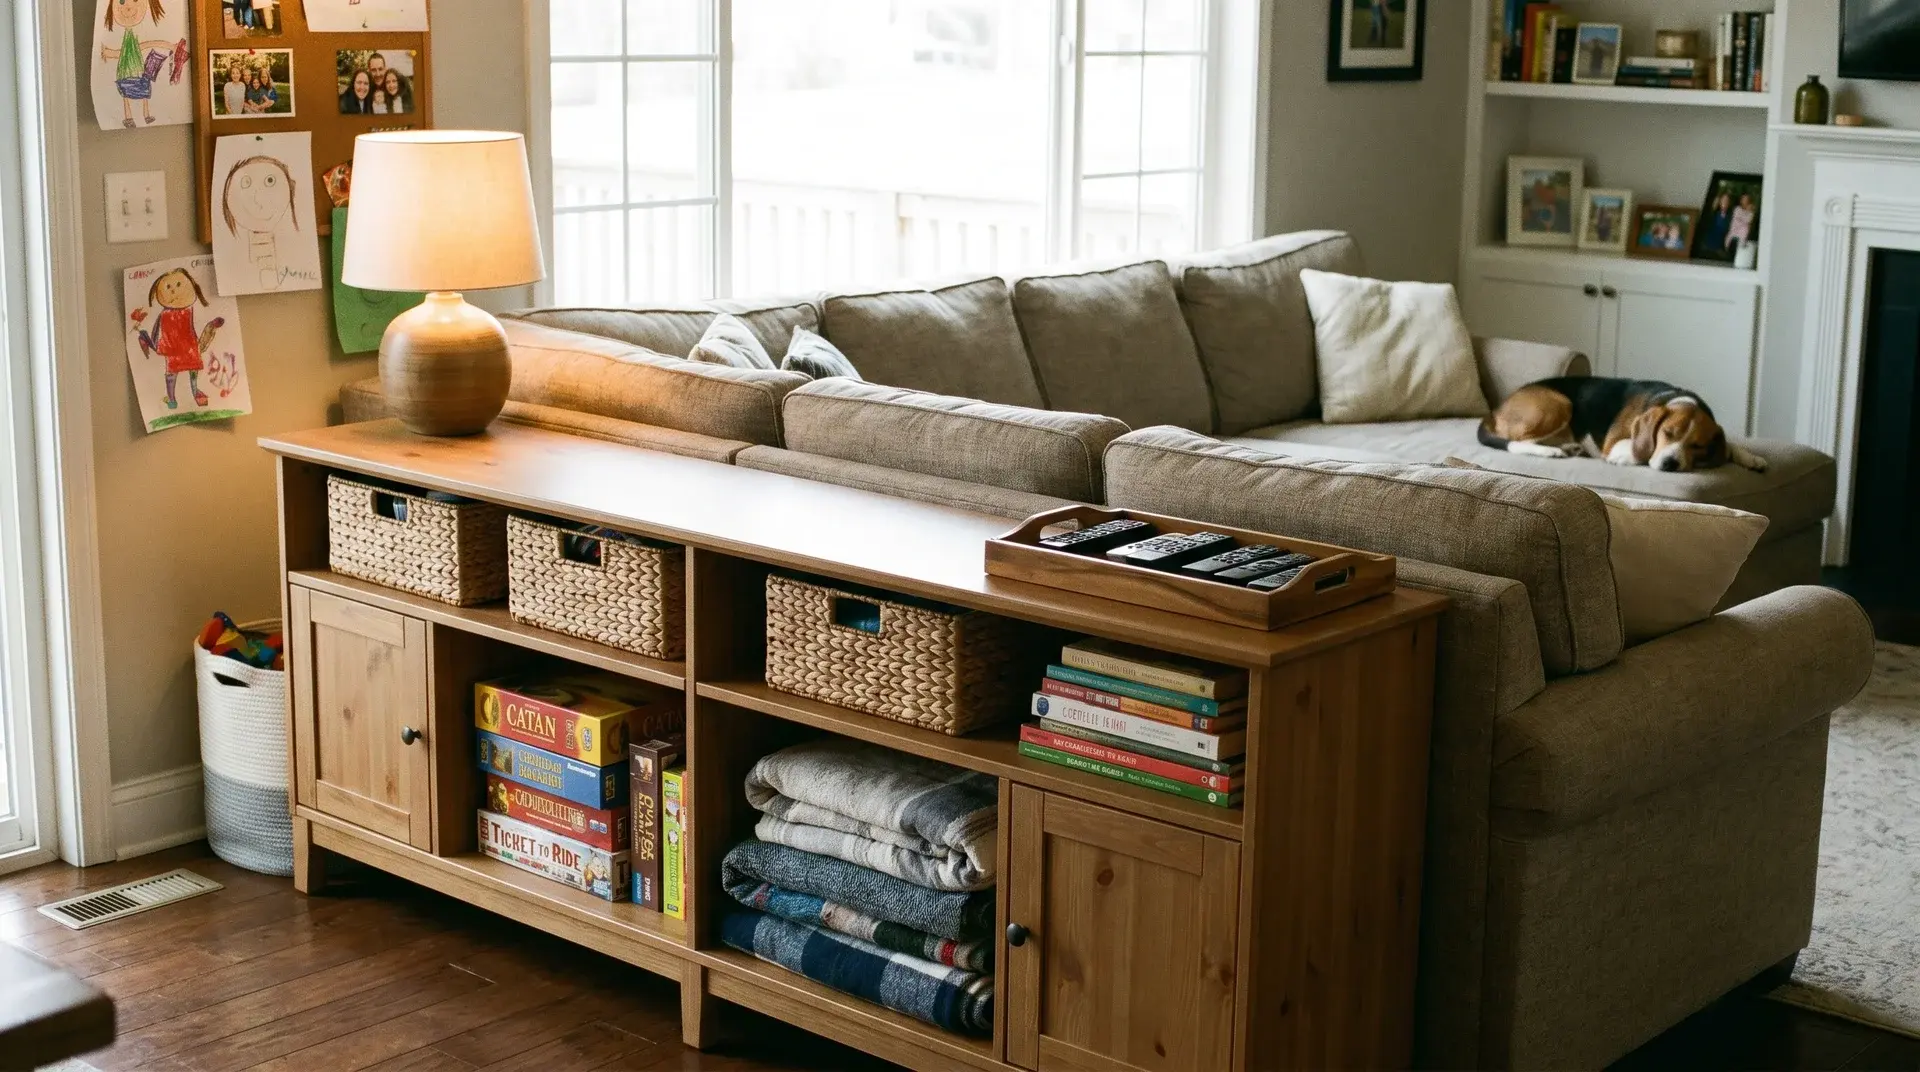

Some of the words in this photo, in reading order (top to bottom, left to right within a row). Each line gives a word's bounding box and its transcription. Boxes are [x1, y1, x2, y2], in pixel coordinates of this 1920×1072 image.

[506, 703, 557, 739] CATAN
[491, 822, 536, 856] TICKET
[537, 843, 550, 858] TO
[552, 842, 582, 872] RIDE
